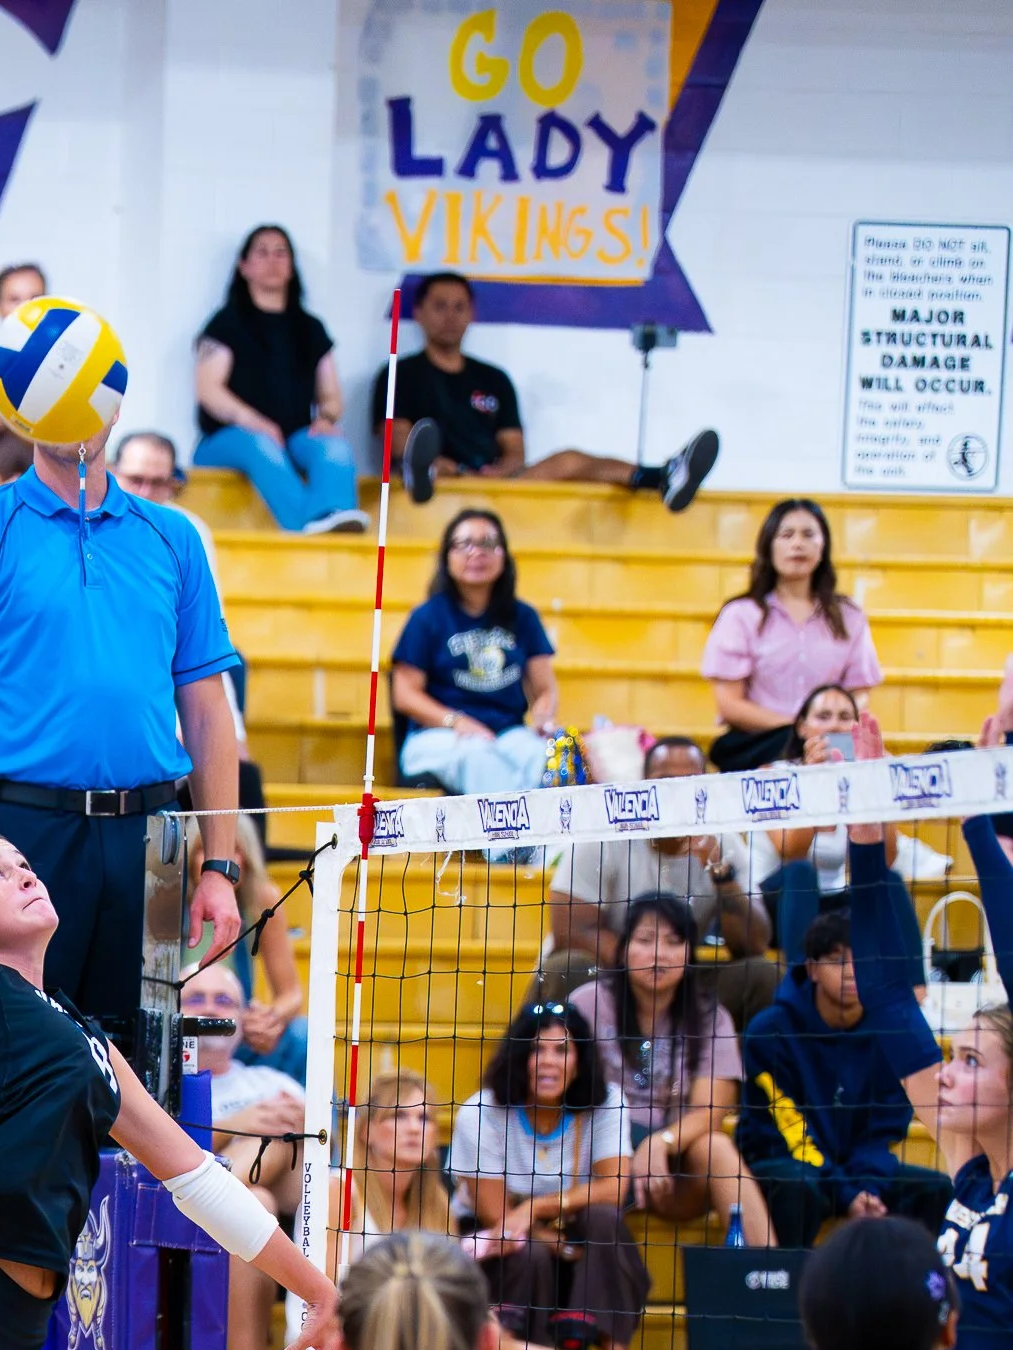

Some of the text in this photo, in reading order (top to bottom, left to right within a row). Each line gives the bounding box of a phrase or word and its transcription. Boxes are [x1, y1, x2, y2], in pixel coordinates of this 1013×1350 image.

[448, 8, 584, 109] GO
[385, 95, 658, 195] LADY
[383, 187, 651, 268] VIKINGS!
[891, 308, 965, 325] MAJOR
[860, 330, 994, 350] STRUCTURAL
[881, 354, 971, 372] DAMAGE
[859, 376, 992, 395] WILL OCCUR.
[477, 795, 531, 833] VALENCIA
[301, 1162, 313, 1258] VOLLEYBAL
